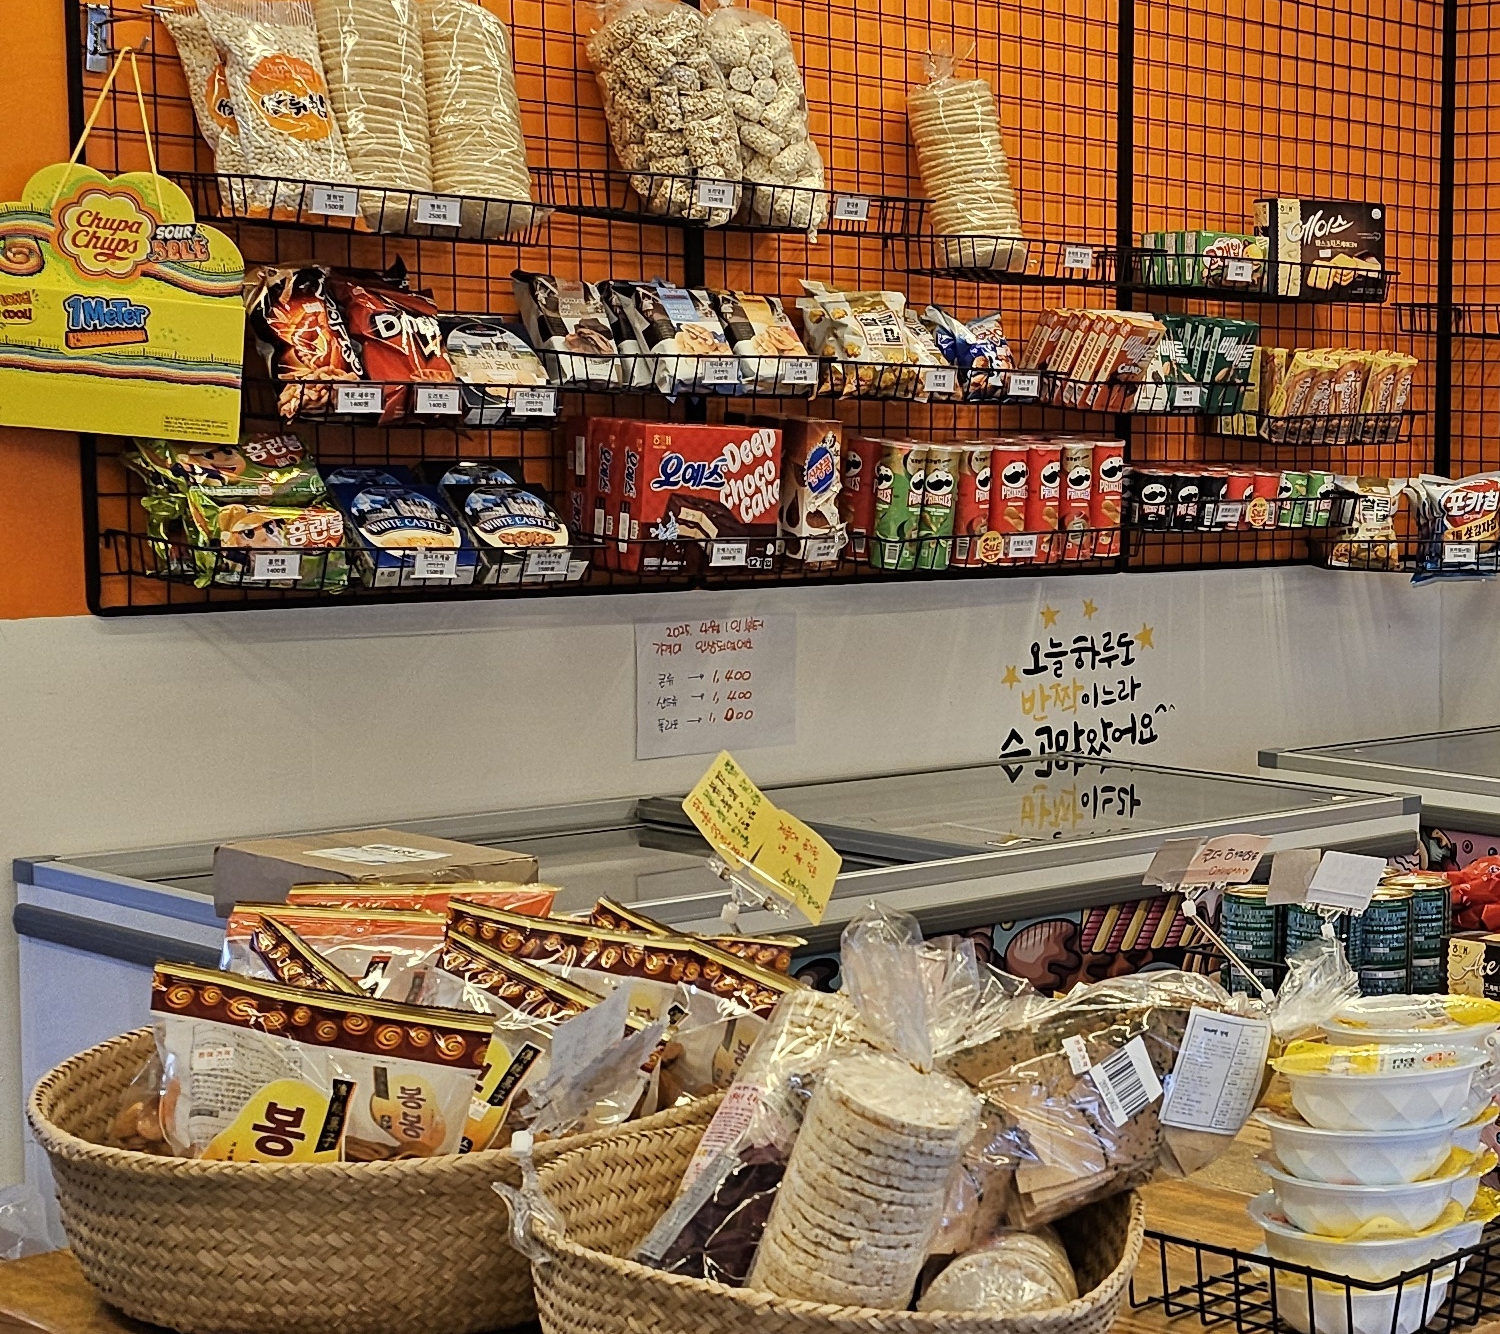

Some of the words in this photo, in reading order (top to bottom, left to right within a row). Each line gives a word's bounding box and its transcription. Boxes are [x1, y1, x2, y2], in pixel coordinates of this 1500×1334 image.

[76, 210, 143, 237] Chupa
[156, 225, 193, 239] SOUR
[1287, 210, 1354, 247] 에이스
[71, 234, 139, 262] Chups
[722, 429, 776, 473] Deep
[651, 451, 729, 491] 오예스
[924, 493, 952, 508] PRINGLES
[1447, 491, 1500, 516] 포카칩
[286, 511, 343, 545] 홈런볼
[367, 517, 404, 533] WHITE
[405, 517, 447, 533] CASTLE
[479, 517, 514, 531] WHITE
[514, 516, 556, 530] CASTLE
[1460, 949, 1500, 977] Ace
